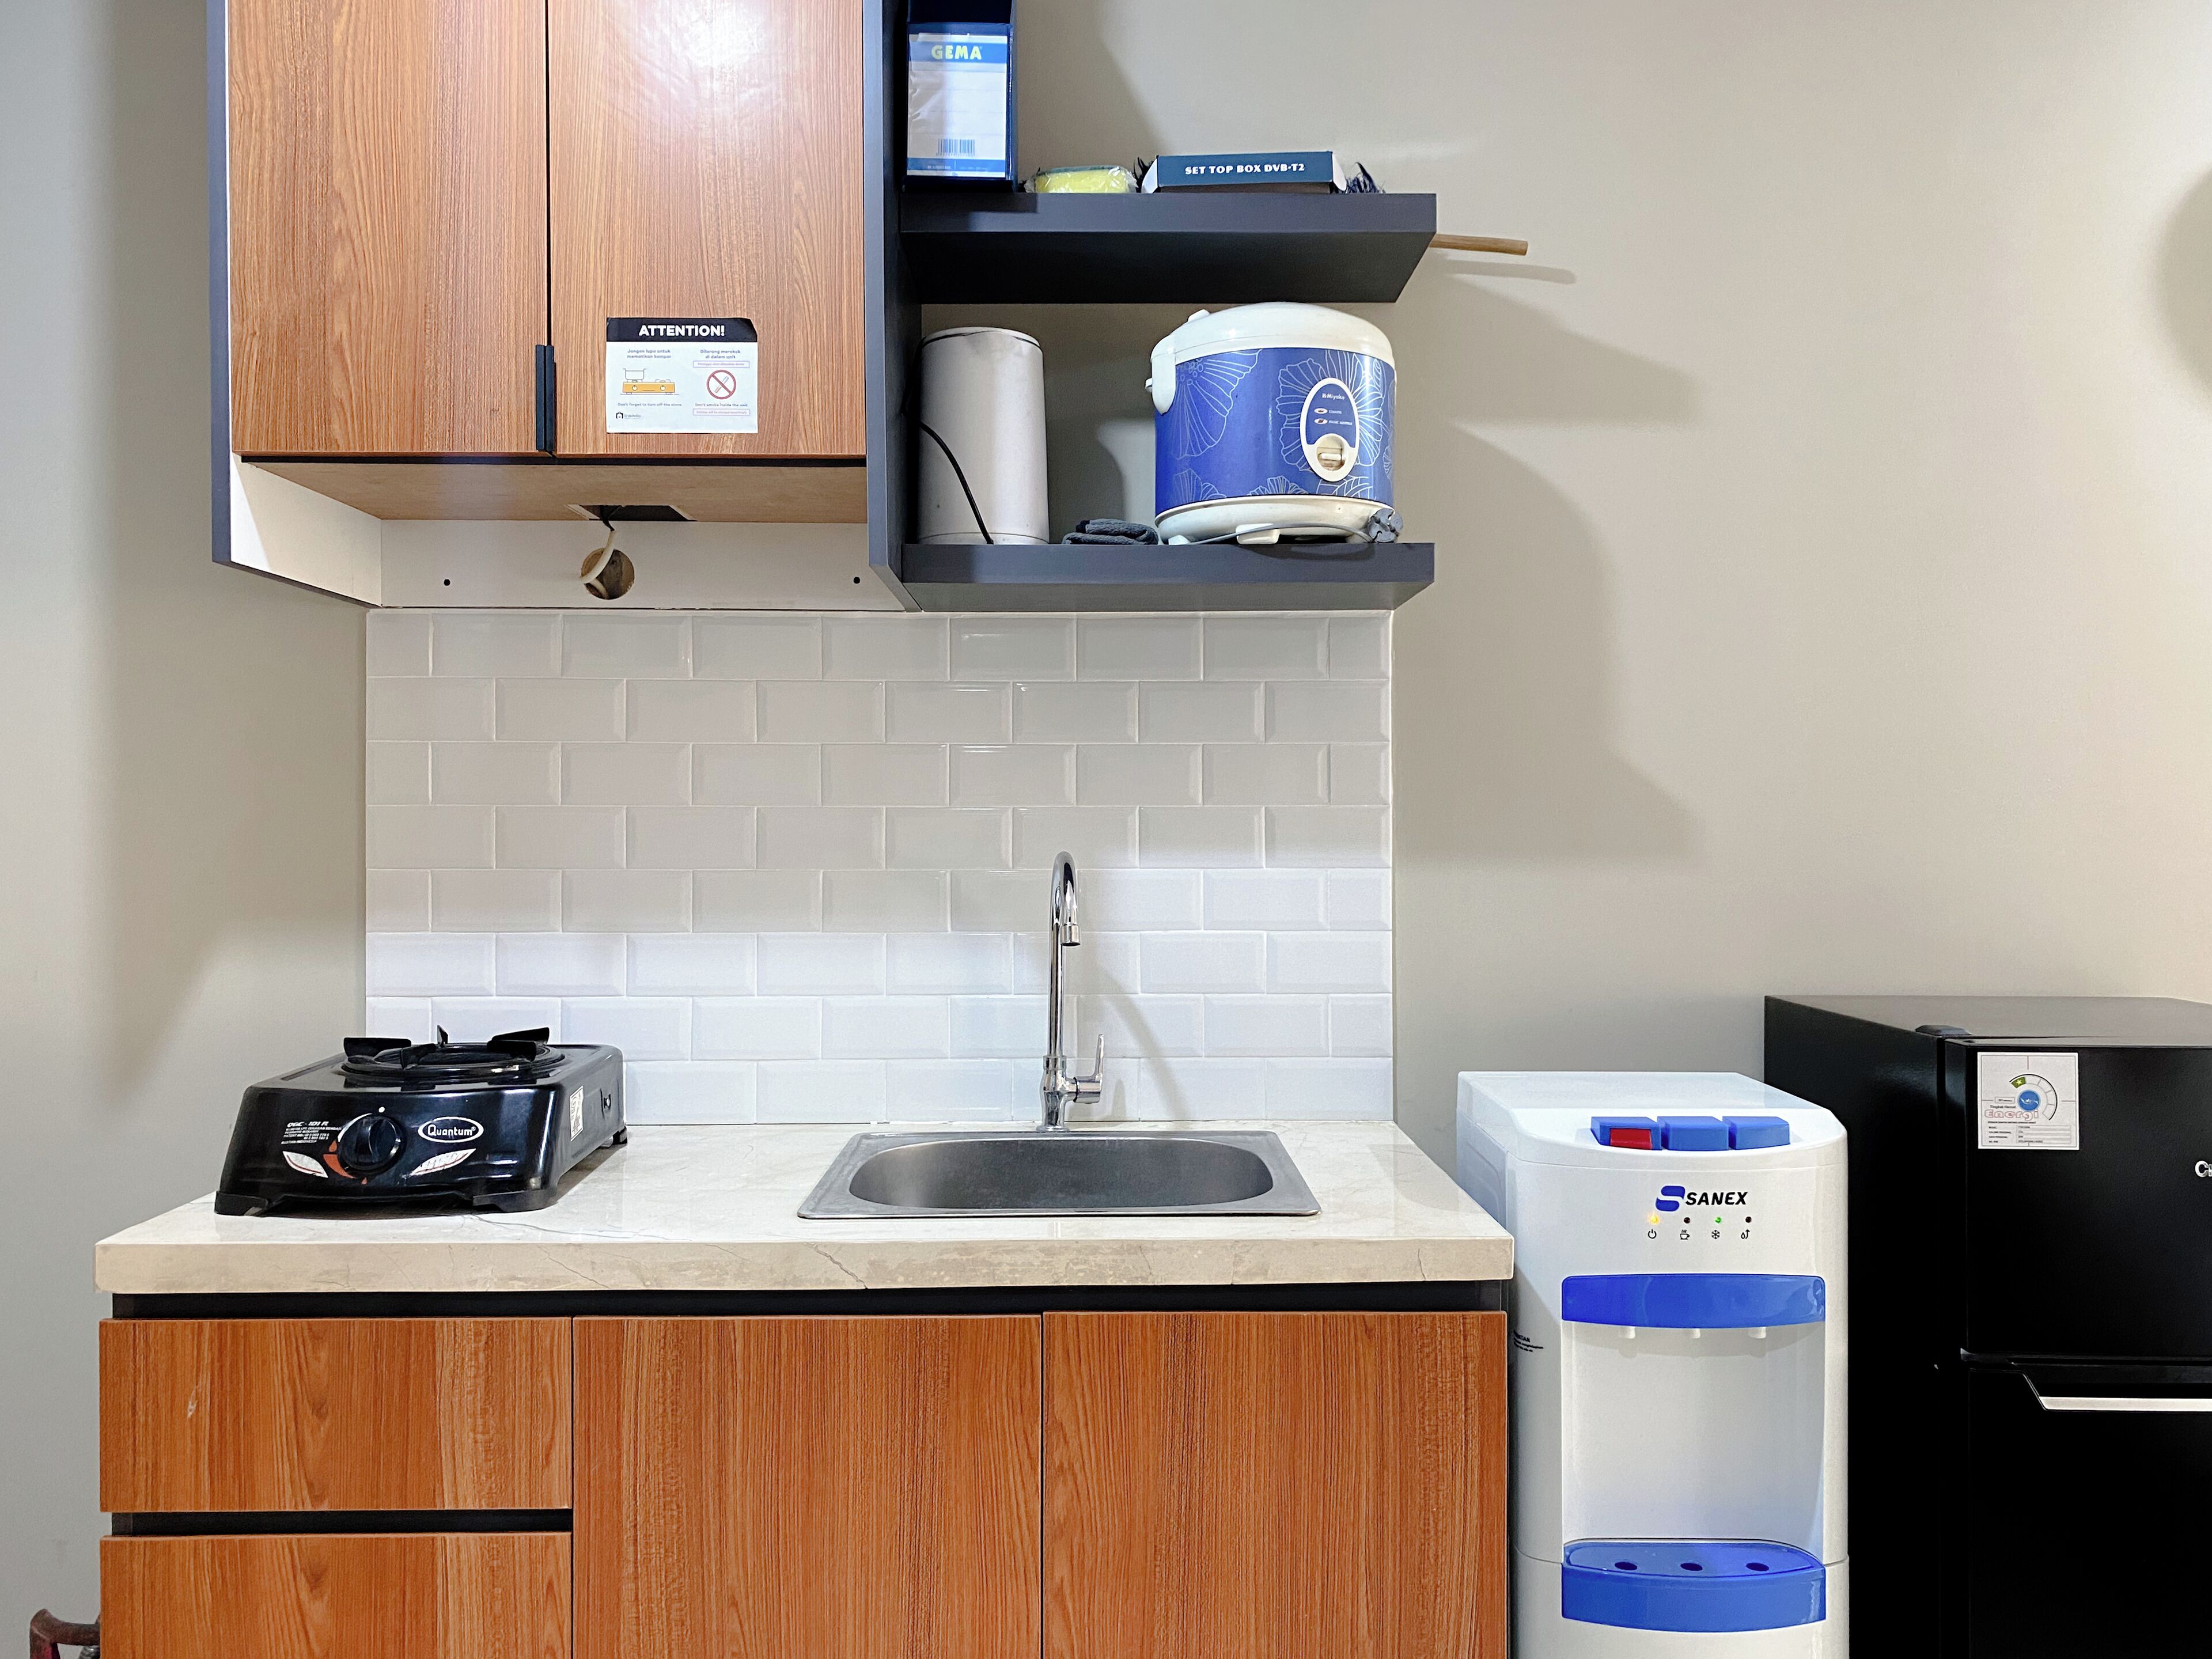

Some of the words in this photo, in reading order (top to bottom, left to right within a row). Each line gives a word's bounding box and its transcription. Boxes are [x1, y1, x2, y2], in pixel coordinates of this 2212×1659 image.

[931, 45, 982, 60] GEMA
[1185, 166, 1206, 175] SET
[1209, 165, 1234, 174] TOP
[1237, 165, 1262, 173] BOX
[1264, 164, 1305, 172] DVB-T2
[638, 324, 725, 336] ATTENTION!
[1984, 1109, 2039, 1121] Energi
[428, 1124, 472, 1136] Quantum
[2195, 1160, 2212, 1177] C
[1685, 1191, 1748, 1206] SANEX
